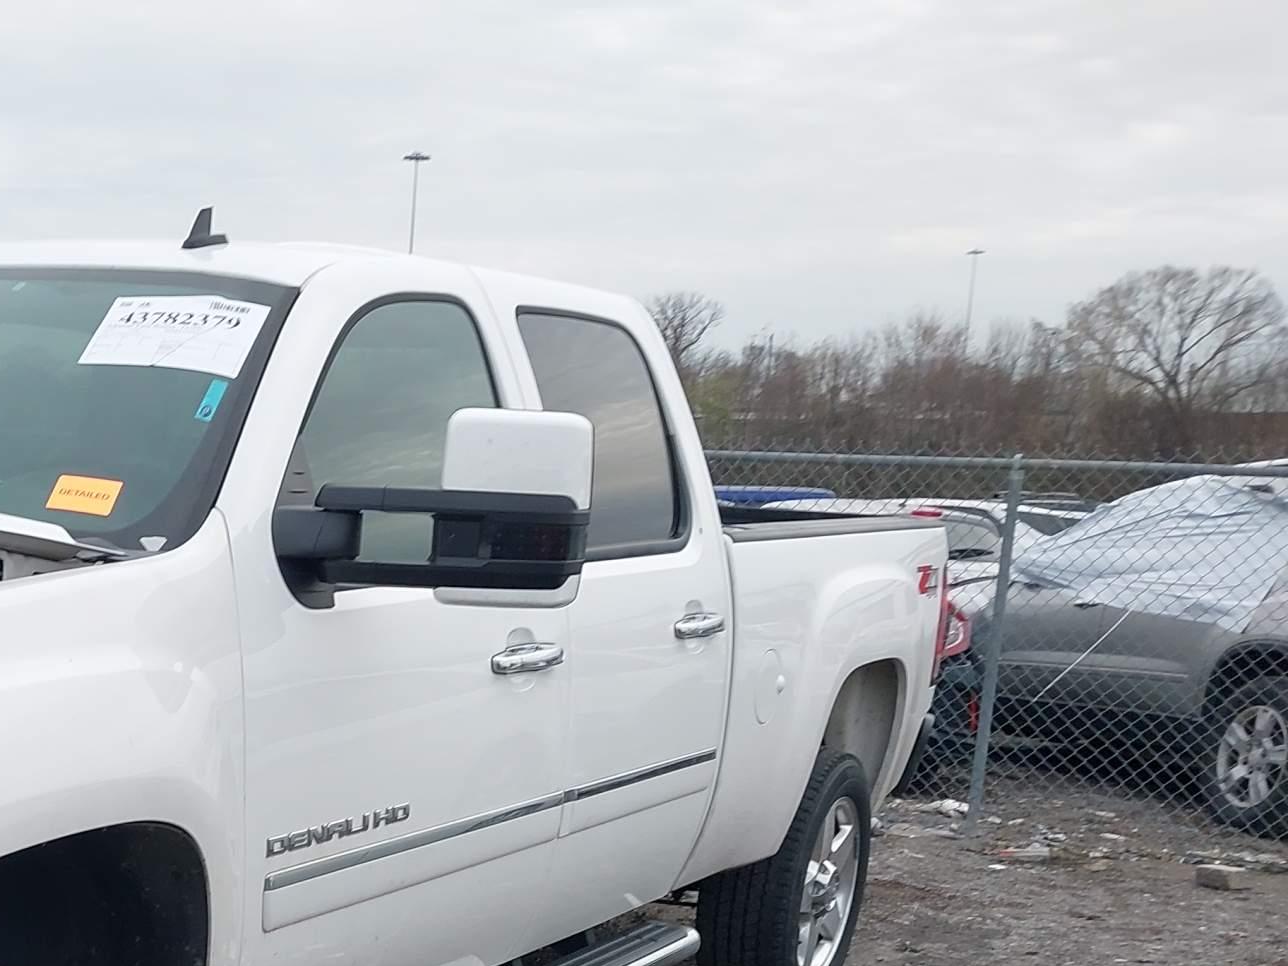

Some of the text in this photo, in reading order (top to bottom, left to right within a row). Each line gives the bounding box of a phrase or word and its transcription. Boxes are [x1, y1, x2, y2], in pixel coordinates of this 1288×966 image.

[119, 311, 242, 329] 43782379
[58, 487, 111, 501] DETAILED
[265, 802, 411, 858] DENALI HD
